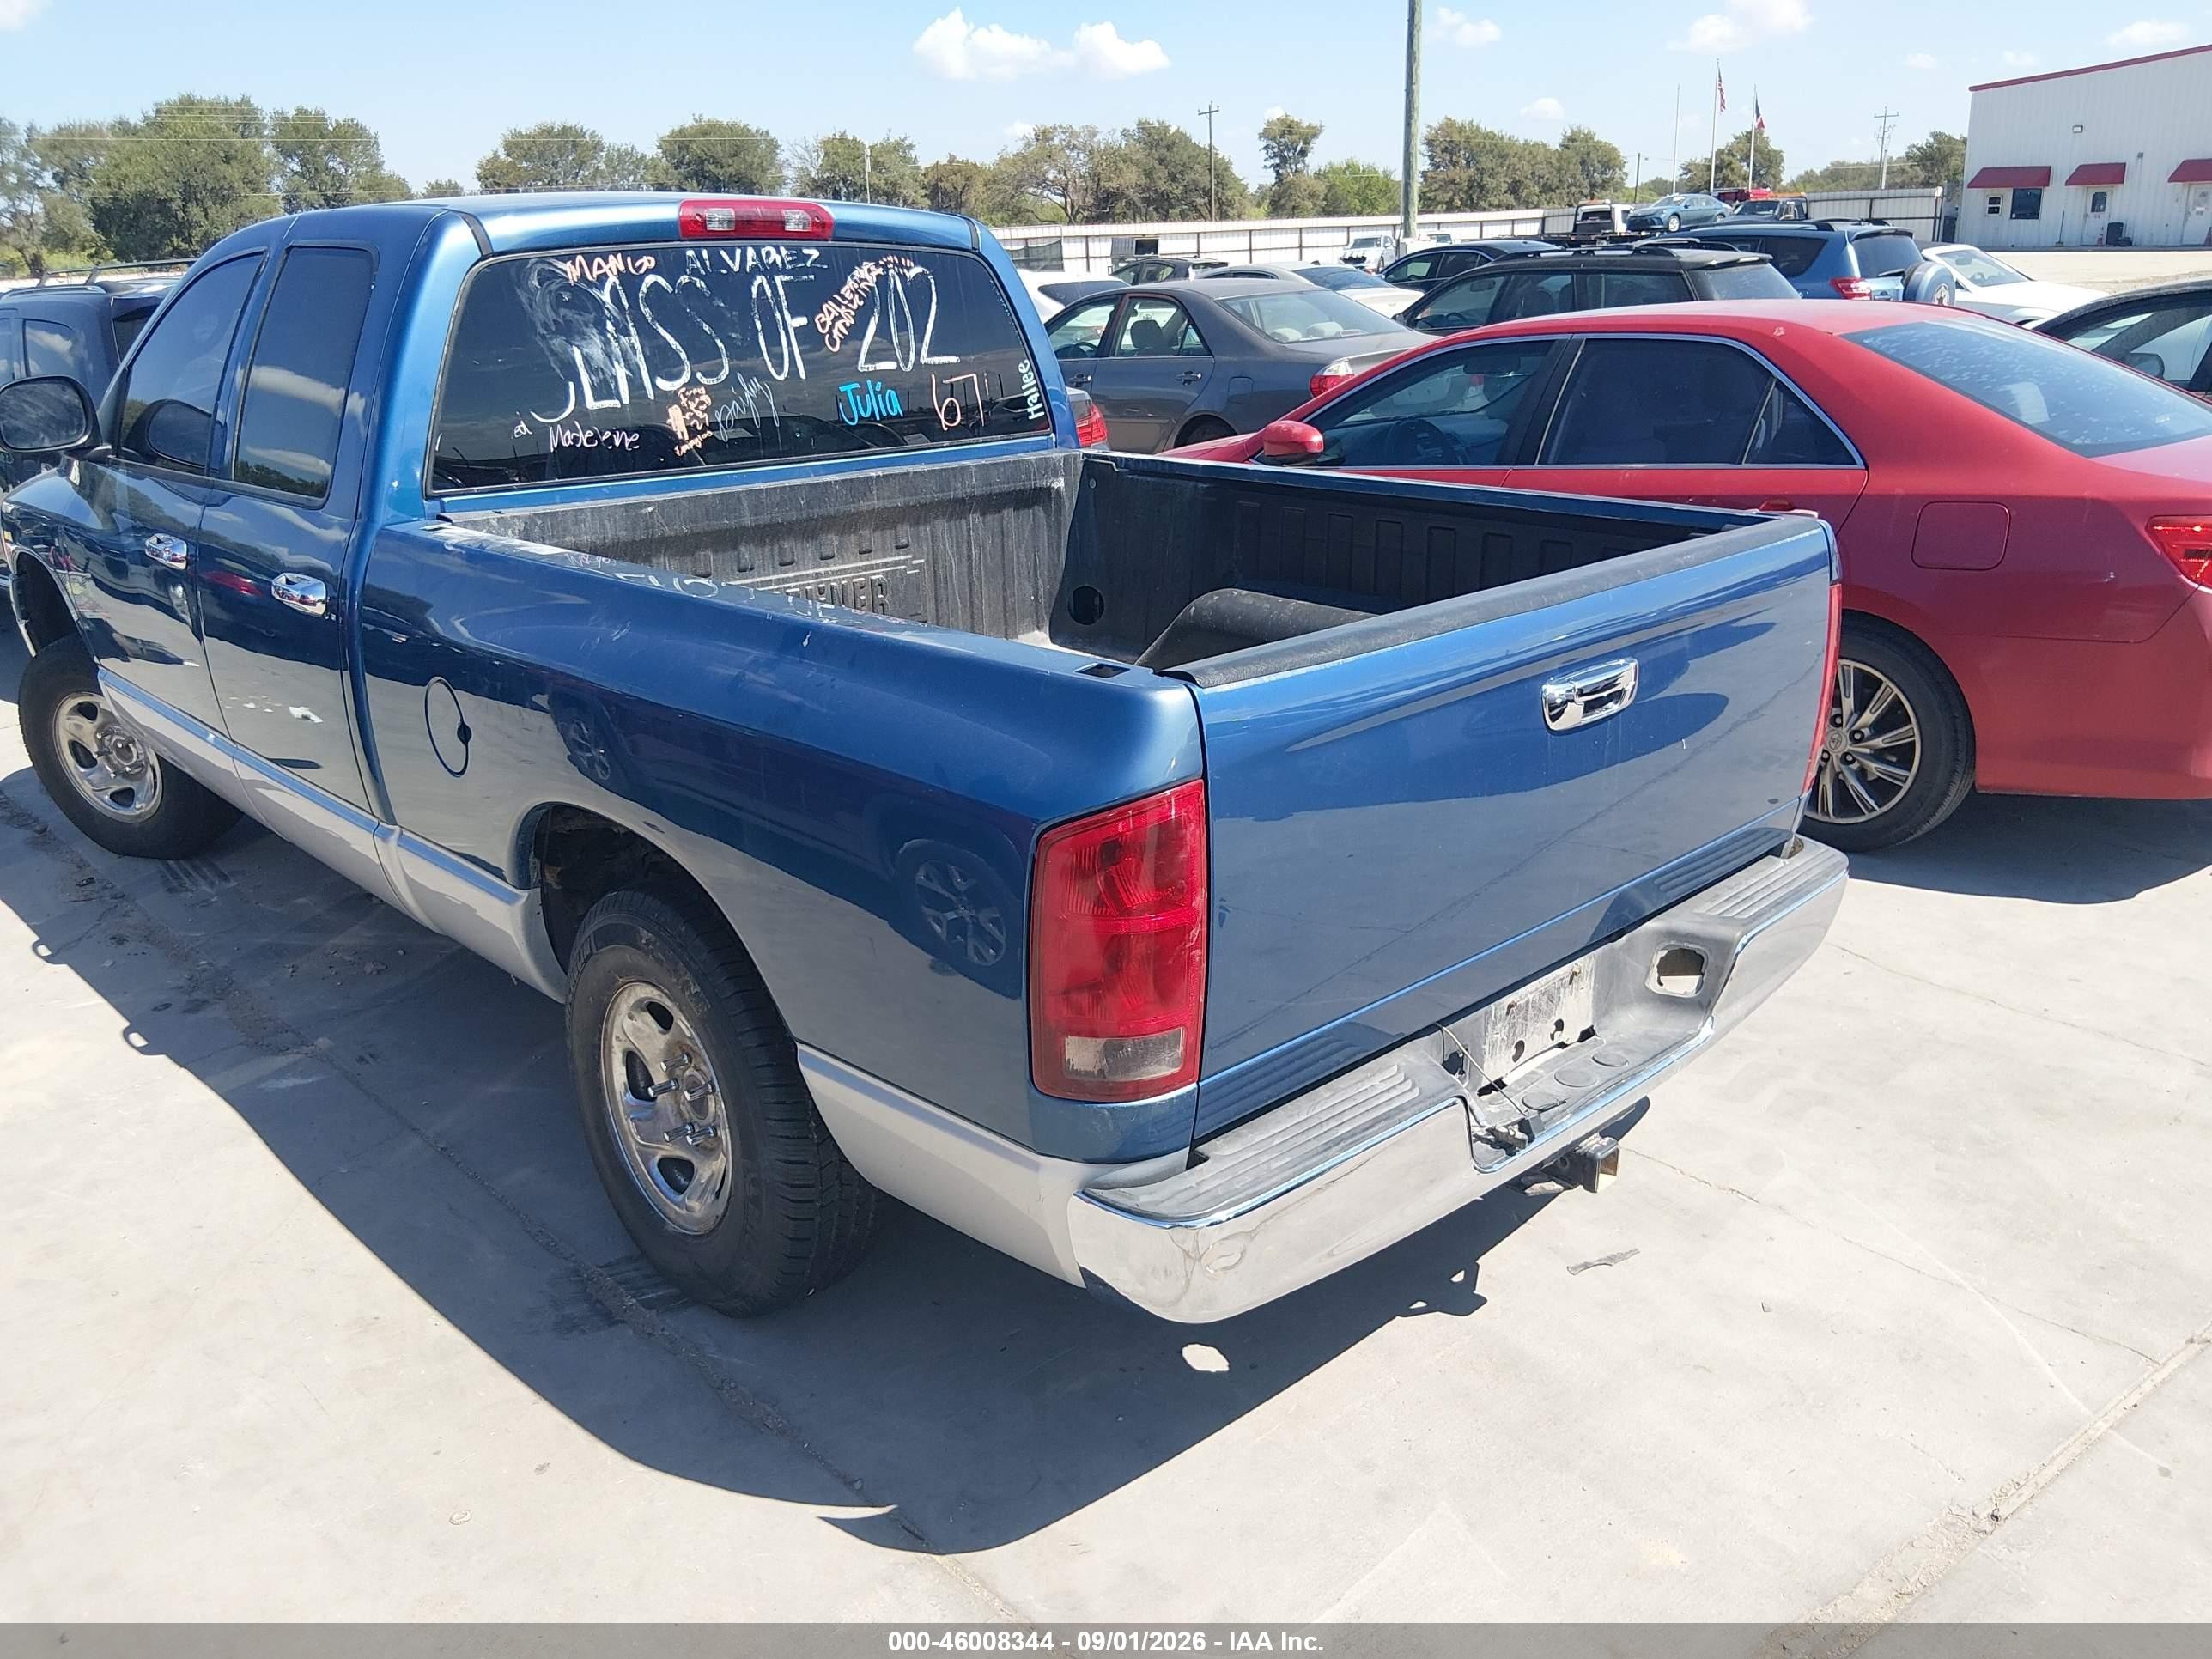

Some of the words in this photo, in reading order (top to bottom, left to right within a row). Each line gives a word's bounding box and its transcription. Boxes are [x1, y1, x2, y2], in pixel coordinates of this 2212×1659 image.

[684, 246, 829, 276] ALVAREZ
[751, 273, 815, 381] OF
[838, 379, 903, 426] Julia
[1017, 359, 1045, 421] Hallee
